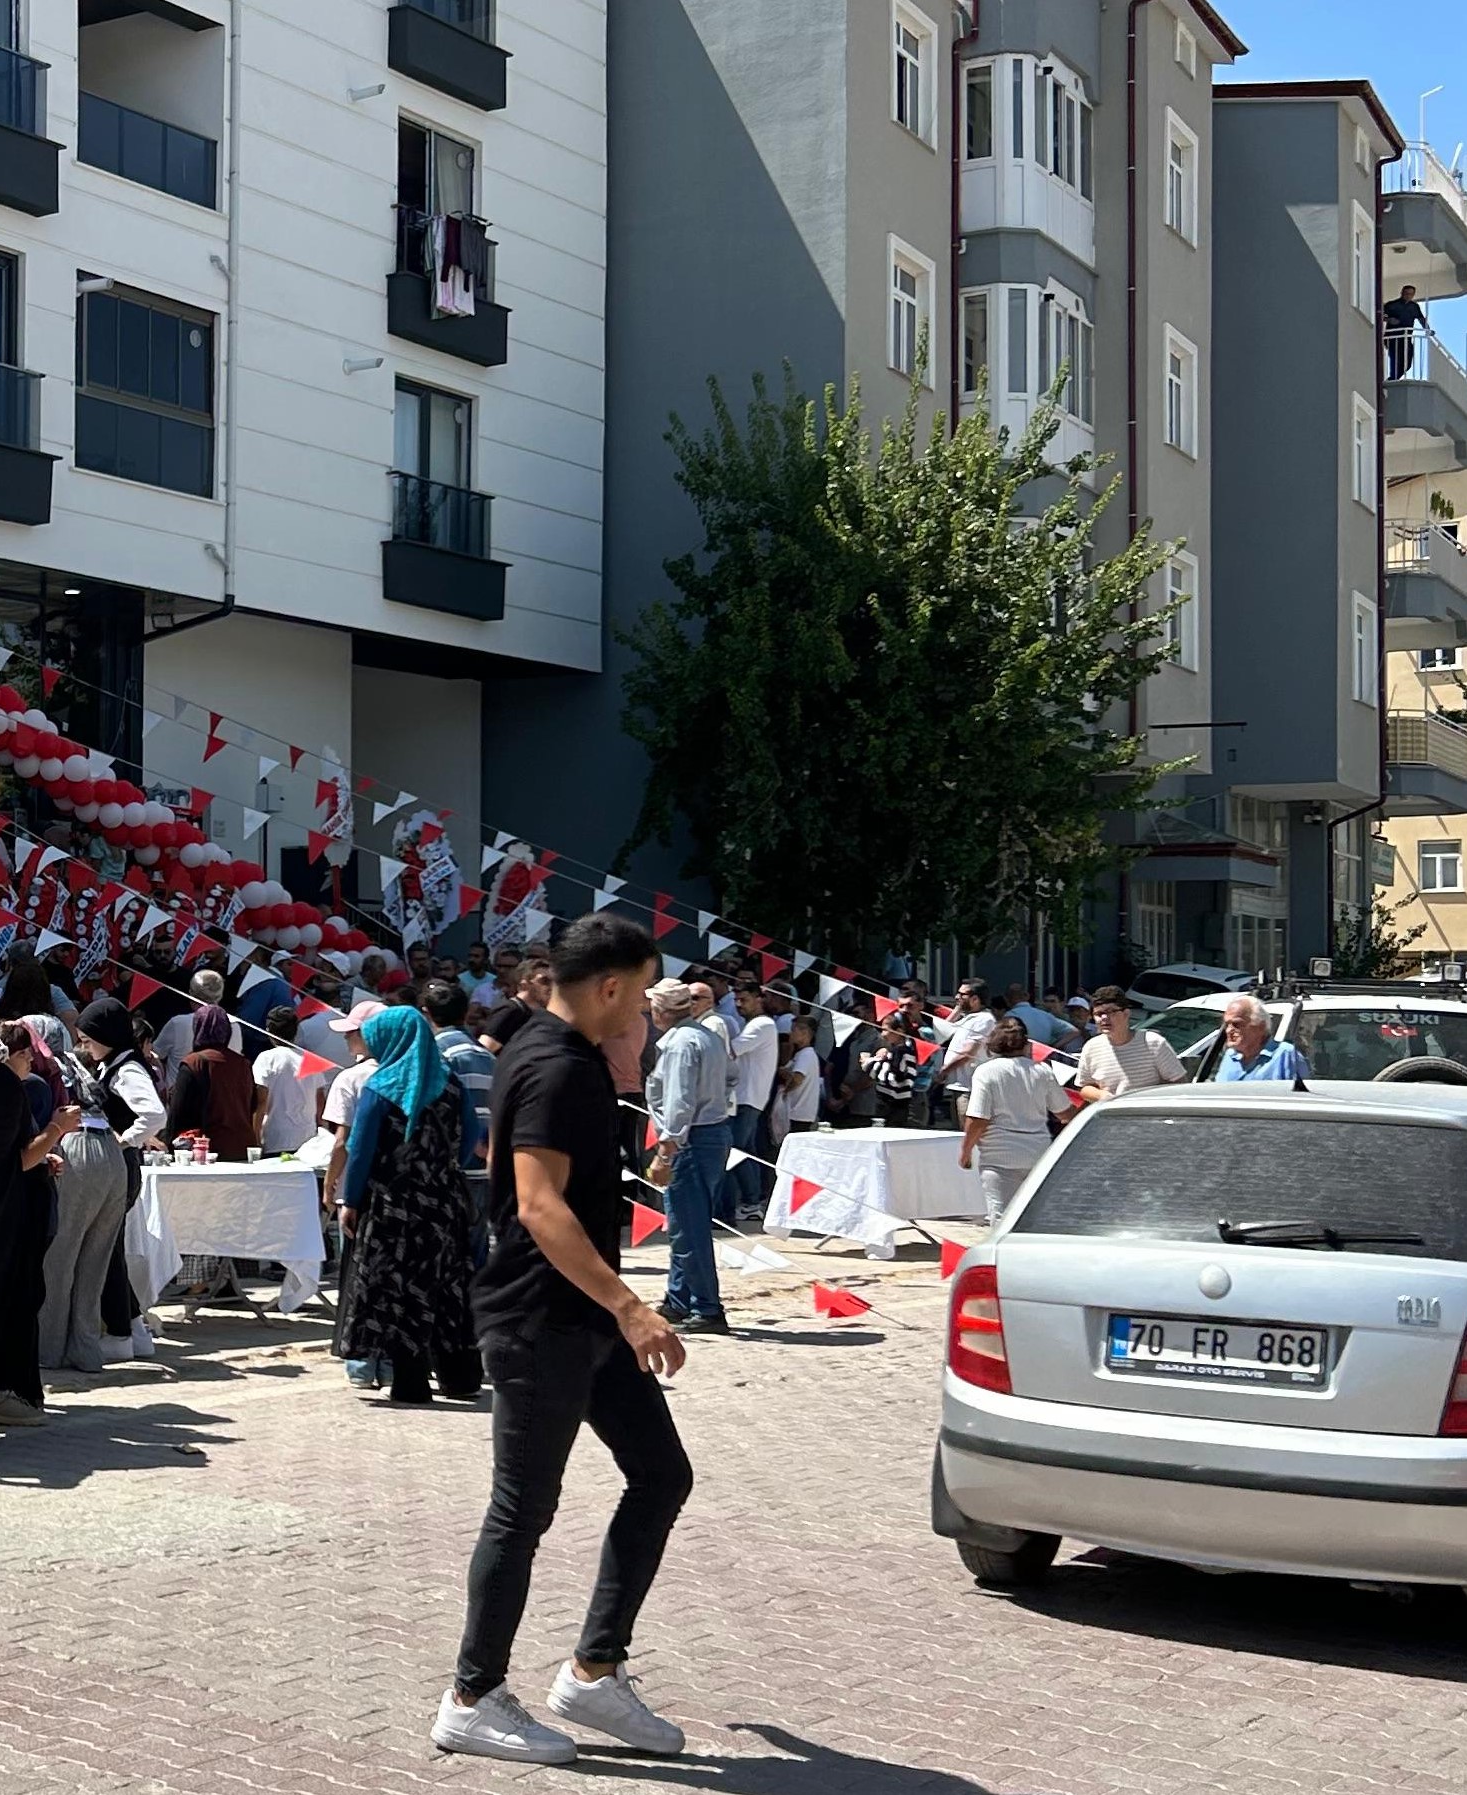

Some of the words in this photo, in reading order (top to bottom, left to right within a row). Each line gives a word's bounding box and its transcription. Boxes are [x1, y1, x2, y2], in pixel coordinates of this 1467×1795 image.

[1358, 1012, 1440, 1025] SUZUKI
[1130, 1324, 1164, 1356] 70
[1192, 1327, 1229, 1361] FR
[1257, 1332, 1316, 1367] 868
[1196, 1366, 1222, 1376] OTO
